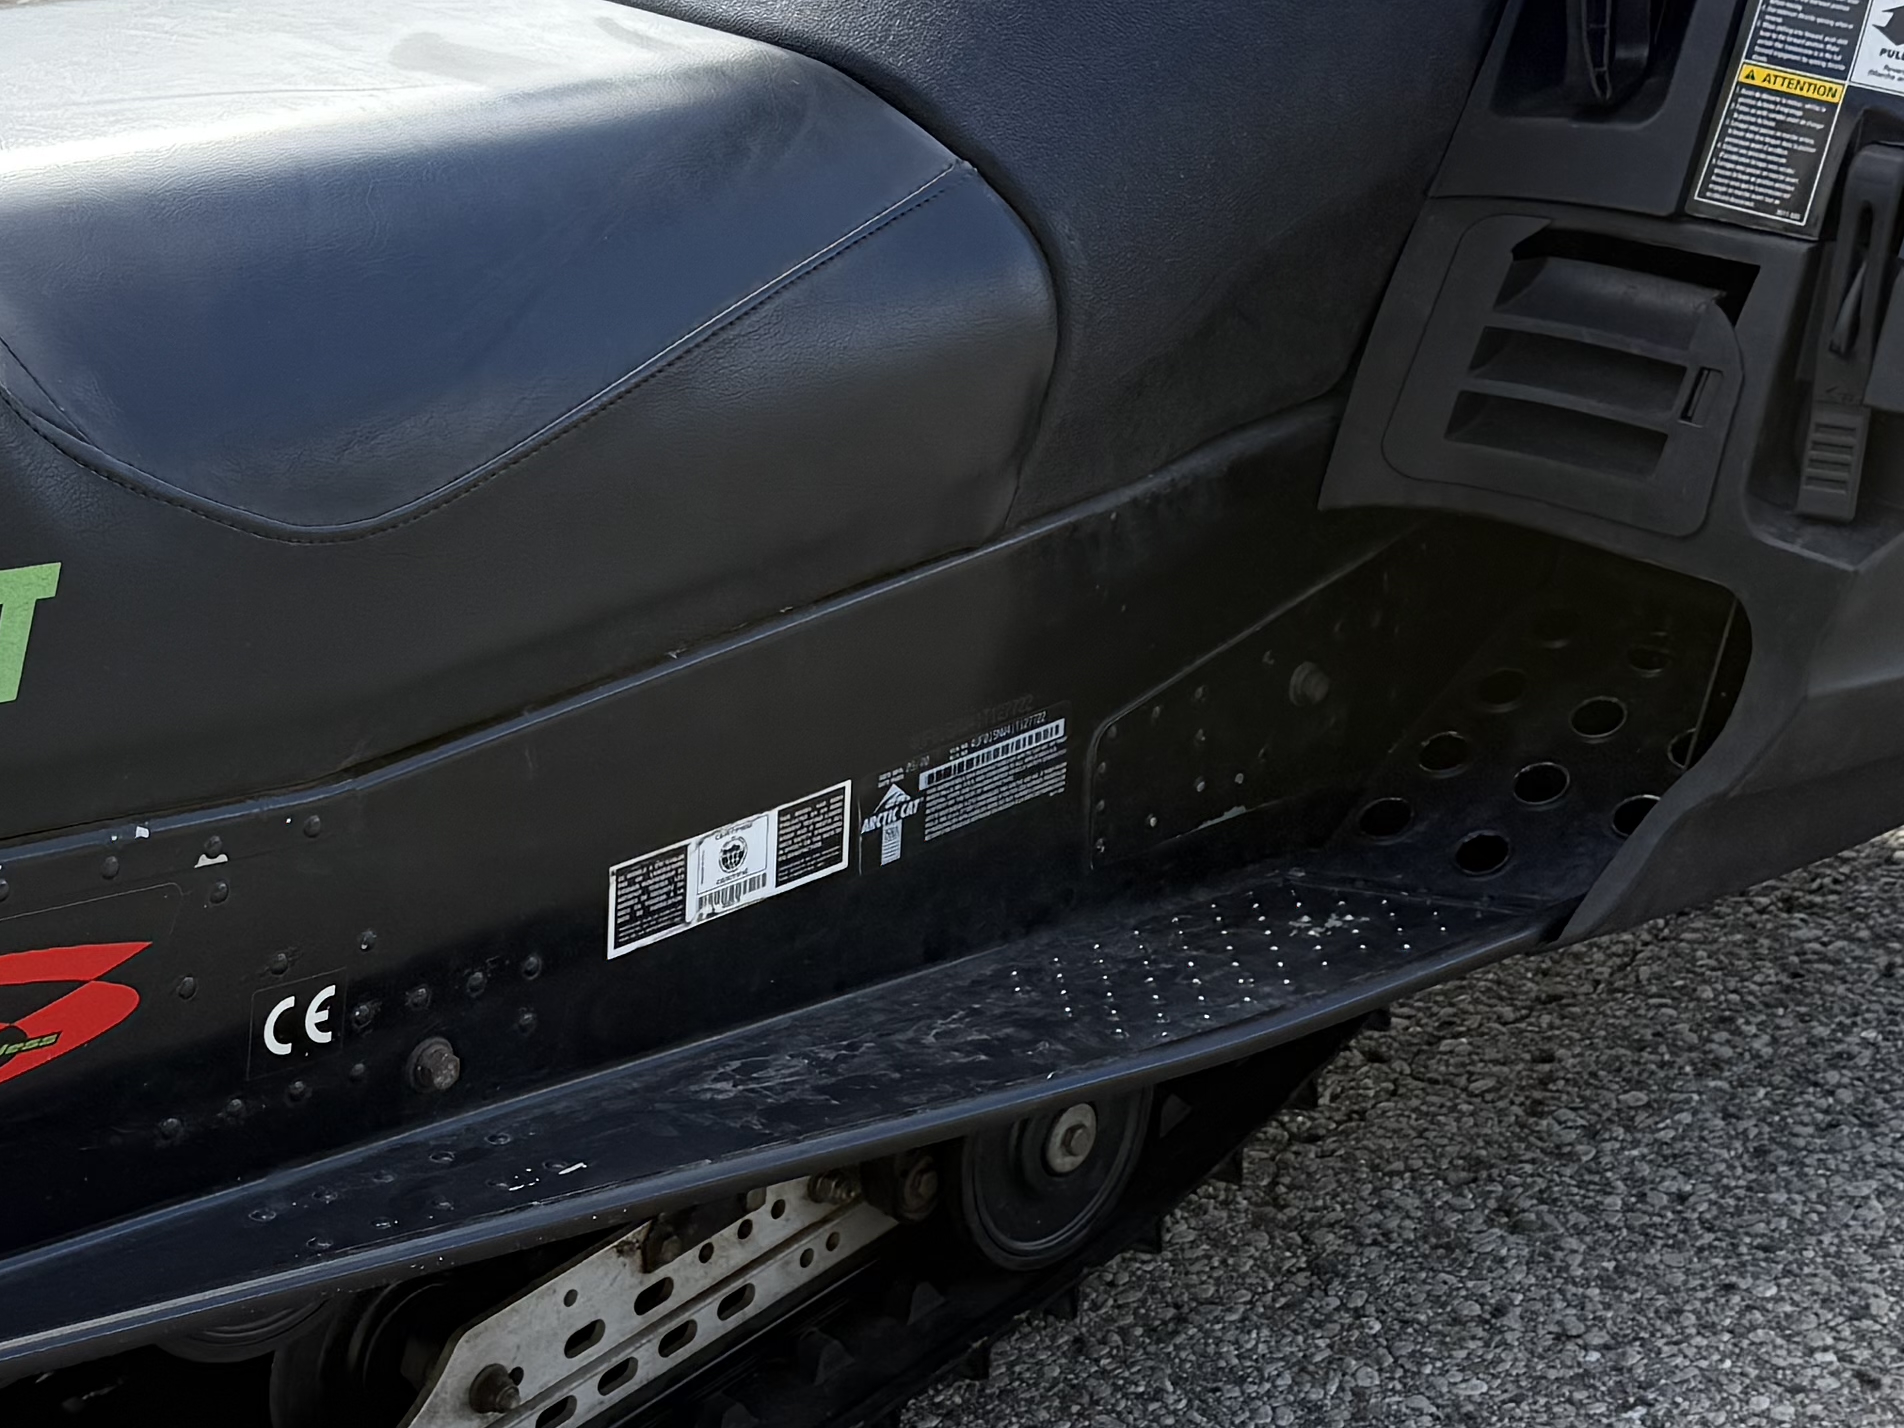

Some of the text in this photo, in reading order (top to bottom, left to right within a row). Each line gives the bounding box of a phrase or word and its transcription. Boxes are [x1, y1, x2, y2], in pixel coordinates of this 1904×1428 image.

[1761, 72, 1838, 99] ATTENTION
[860, 798, 920, 835] ARCTIC CAT
